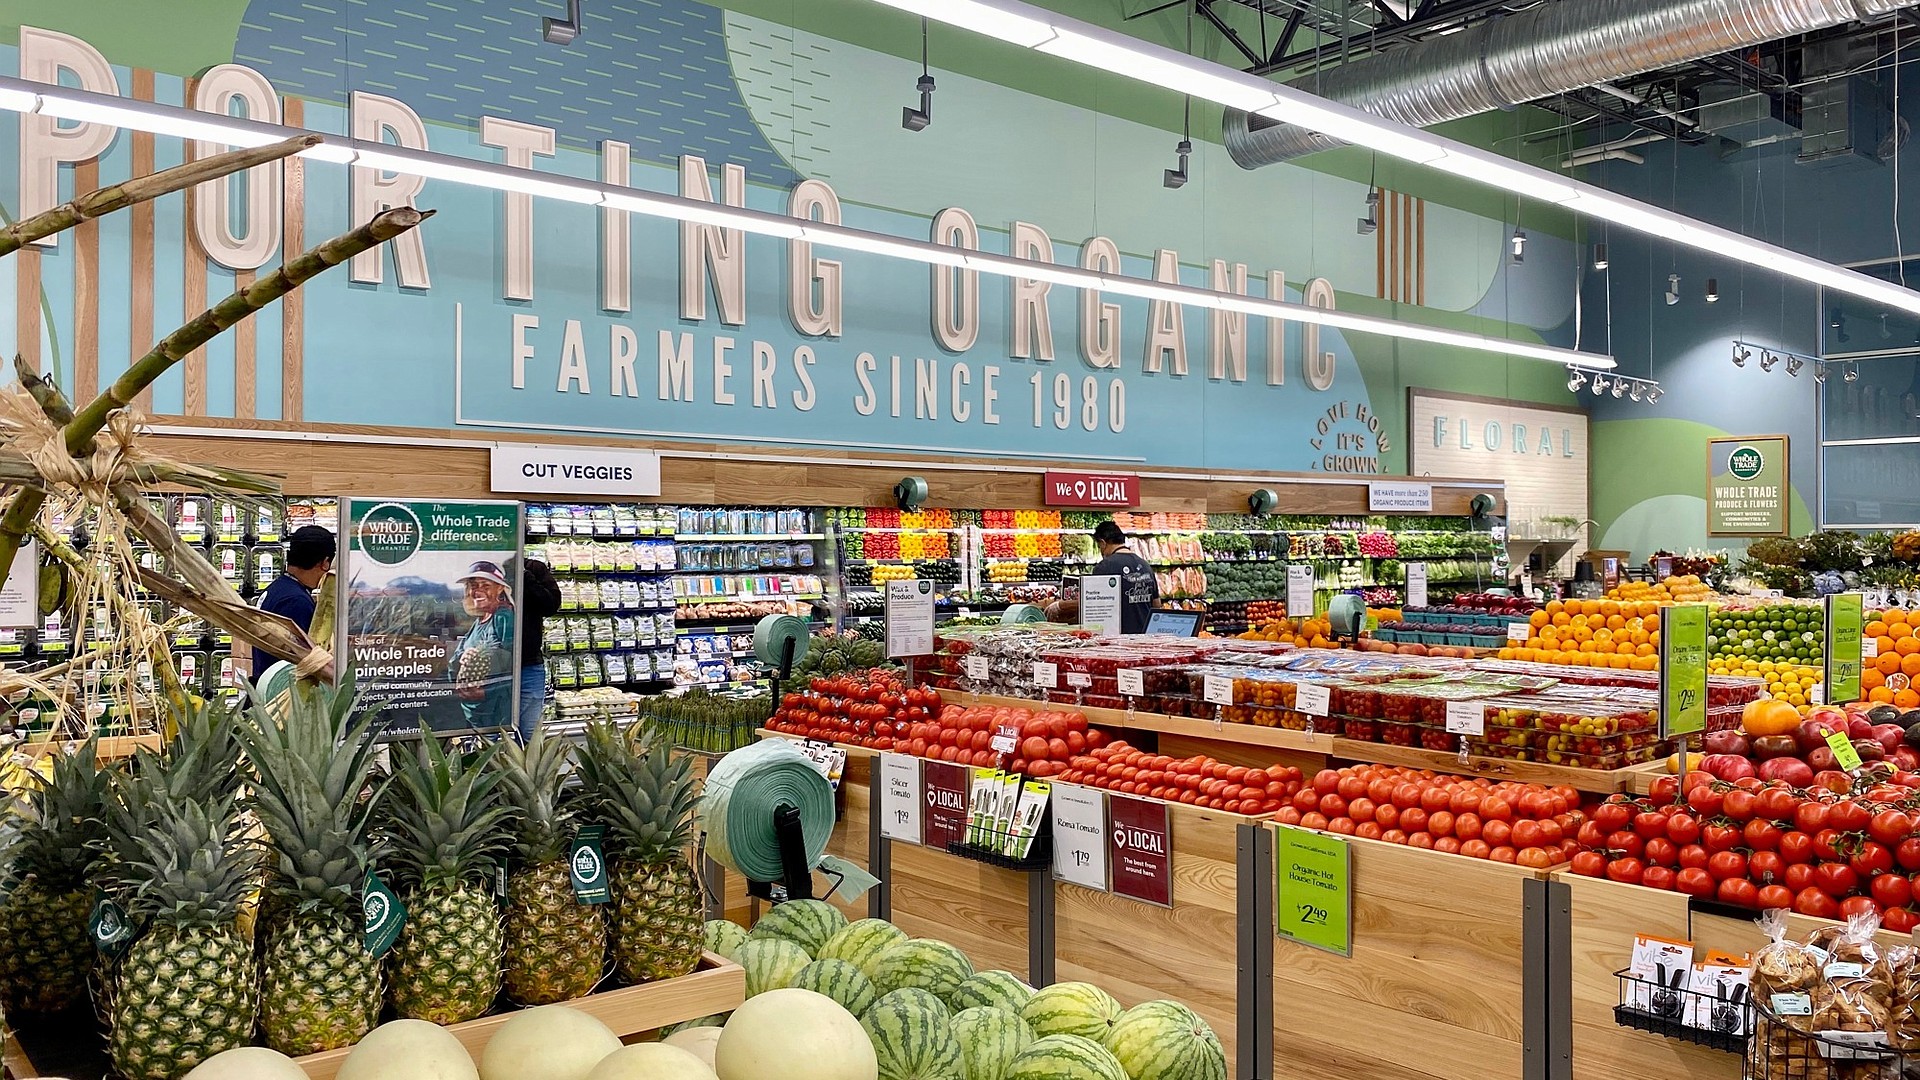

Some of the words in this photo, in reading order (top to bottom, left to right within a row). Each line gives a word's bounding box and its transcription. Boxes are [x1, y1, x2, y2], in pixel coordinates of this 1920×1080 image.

[19, 24, 843, 338] PORTING
[932, 207, 1336, 392] ORGANIC
[511, 313, 816, 411] FARMERS
[854, 351, 1000, 425] SINCE
[1029, 370, 1126, 433] 1980
[1310, 400, 1349, 451] LOVE
[1355, 403, 1391, 453] HOW
[1337, 432, 1365, 451] IT'S
[1433, 415, 1575, 458] FLORAL
[1323, 454, 1377, 474] GROWN
[521, 463, 558, 479] CUT
[562, 464, 633, 481] VEGGIES
[1055, 482, 1072, 497] We
[1090, 481, 1128, 501] LOCAL
[1715, 486, 1746, 499] WHOLE
[1748, 486, 1778, 498] TRADE
[432, 504, 447, 512] The
[1715, 500, 1742, 509] PRODUCE
[1749, 500, 1778, 508] FLOWERS
[368, 520, 413, 533] WHOLE
[431, 514, 472, 527] Whole
[475, 515, 510, 528] Trade
[370, 533, 411, 545] TRADE
[431, 529, 498, 542] difference.
[376, 636, 385, 645] of
[355, 646, 402, 662] Whole
[405, 645, 446, 659] Trade
[354, 661, 433, 680] pineapples
[371, 682, 390, 691] fund
[390, 680, 433, 690] community
[388, 691, 406, 700] such
[416, 689, 453, 698] education
[399, 701, 430, 709] centers.
[891, 777, 908, 788] Slicer
[927, 782, 935, 790] We
[890, 787, 911, 799] Tomato
[937, 790, 964, 810] LOCAL
[1057, 817, 1075, 829] Roma
[1076, 821, 1100, 835] Tomato
[1114, 820, 1124, 830] We
[1128, 829, 1164, 854] LOCAL
[1123, 856, 1133, 865] The
[1133, 858, 1144, 867] best
[1144, 861, 1157, 870] from
[1125, 866, 1142, 875] around
[1142, 868, 1156, 878] here.
[1292, 863, 1321, 877] Organic
[1321, 870, 1334, 880] Hot
[1289, 871, 1311, 884] House
[1311, 878, 1338, 891] Tomato
[1639, 947, 1674, 967] vibe
